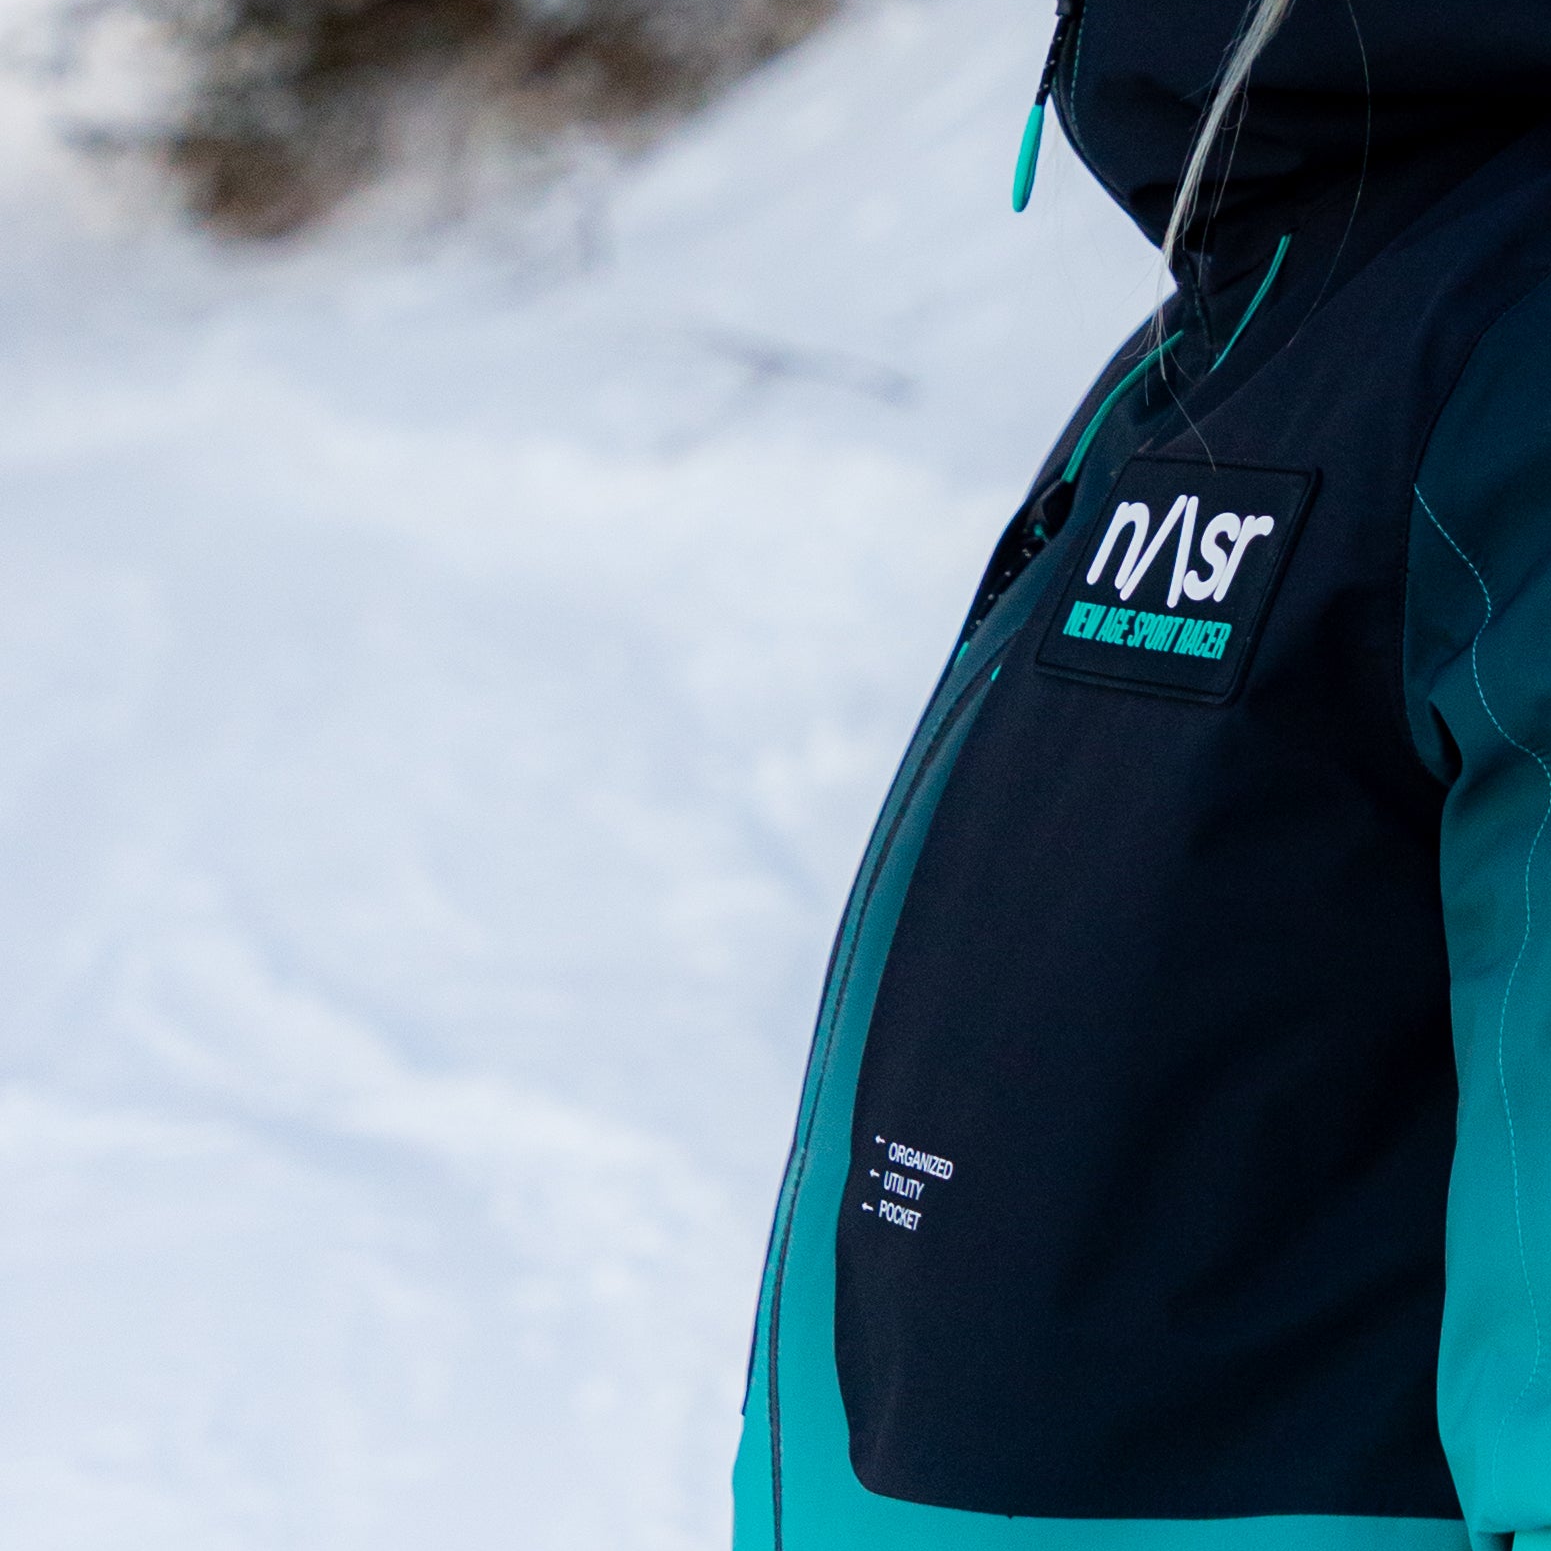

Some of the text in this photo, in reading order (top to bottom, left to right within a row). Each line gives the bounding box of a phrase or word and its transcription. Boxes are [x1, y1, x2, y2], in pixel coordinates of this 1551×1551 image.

[1062, 600, 1233, 660] NEW AGE SPORT RACER
[888, 1142, 954, 1180] ORGANIZED
[883, 1170, 925, 1201] UTILITY
[879, 1199, 922, 1231] POCKET
